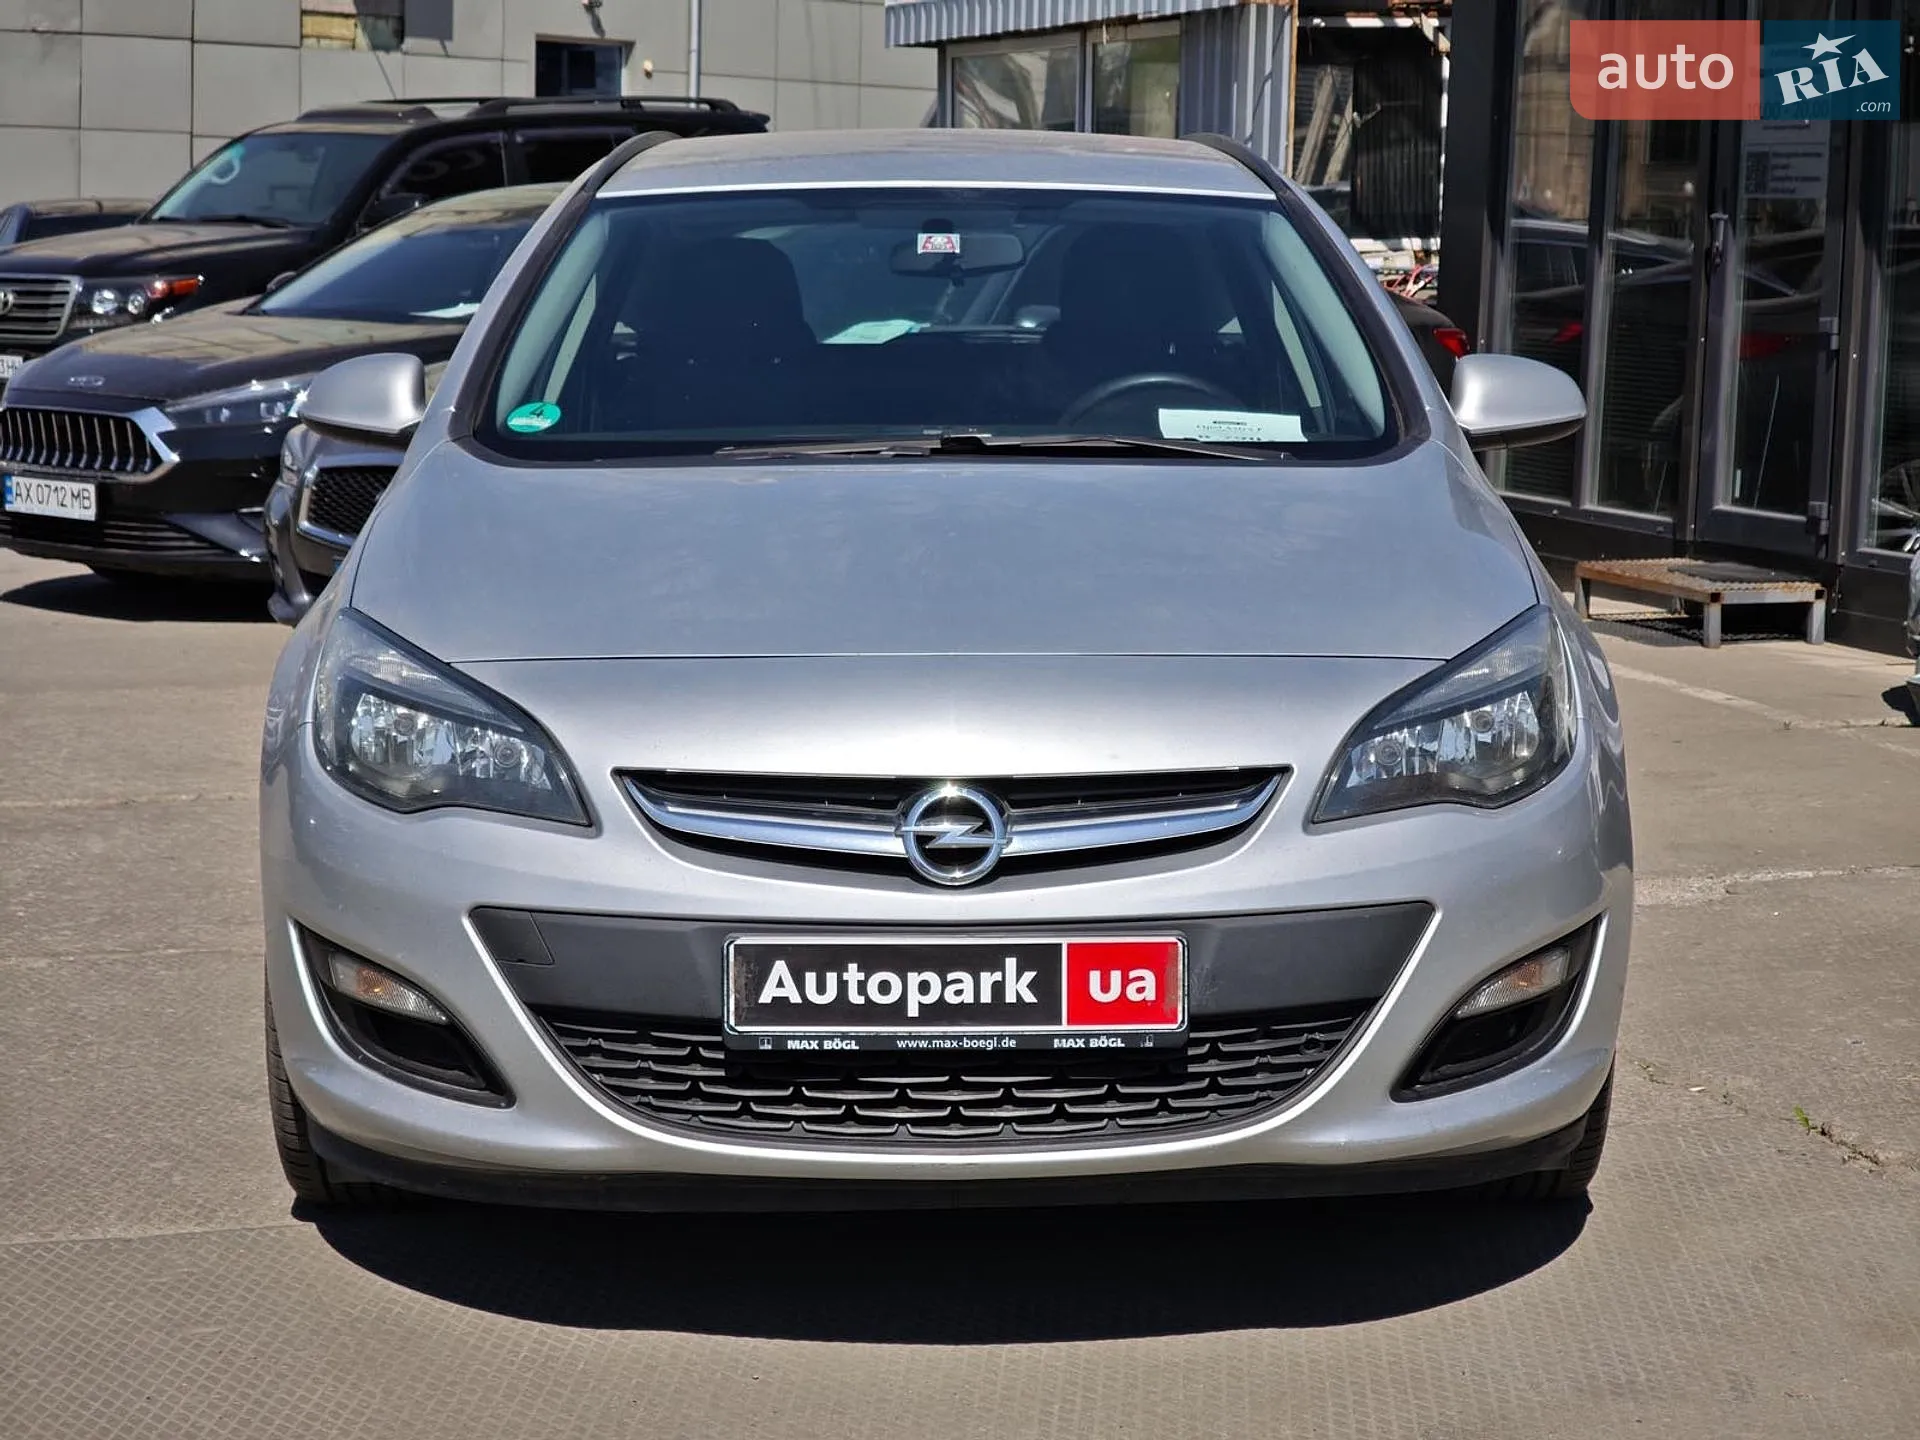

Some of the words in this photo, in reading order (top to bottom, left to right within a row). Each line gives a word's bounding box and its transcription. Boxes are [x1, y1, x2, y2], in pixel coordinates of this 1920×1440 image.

[14, 481, 33, 504] AX
[36, 483, 67, 508] 0712
[71, 487, 92, 510] MB
[758, 958, 1038, 1018] Autopark
[1088, 969, 1157, 1003] ua
[787, 1040, 819, 1050] MAX
[823, 1038, 860, 1050] BÖGL
[896, 1037, 1017, 1051] www.max-boegl.de
[1053, 1038, 1085, 1049] MAX
[1089, 1036, 1125, 1048] BÖGL
